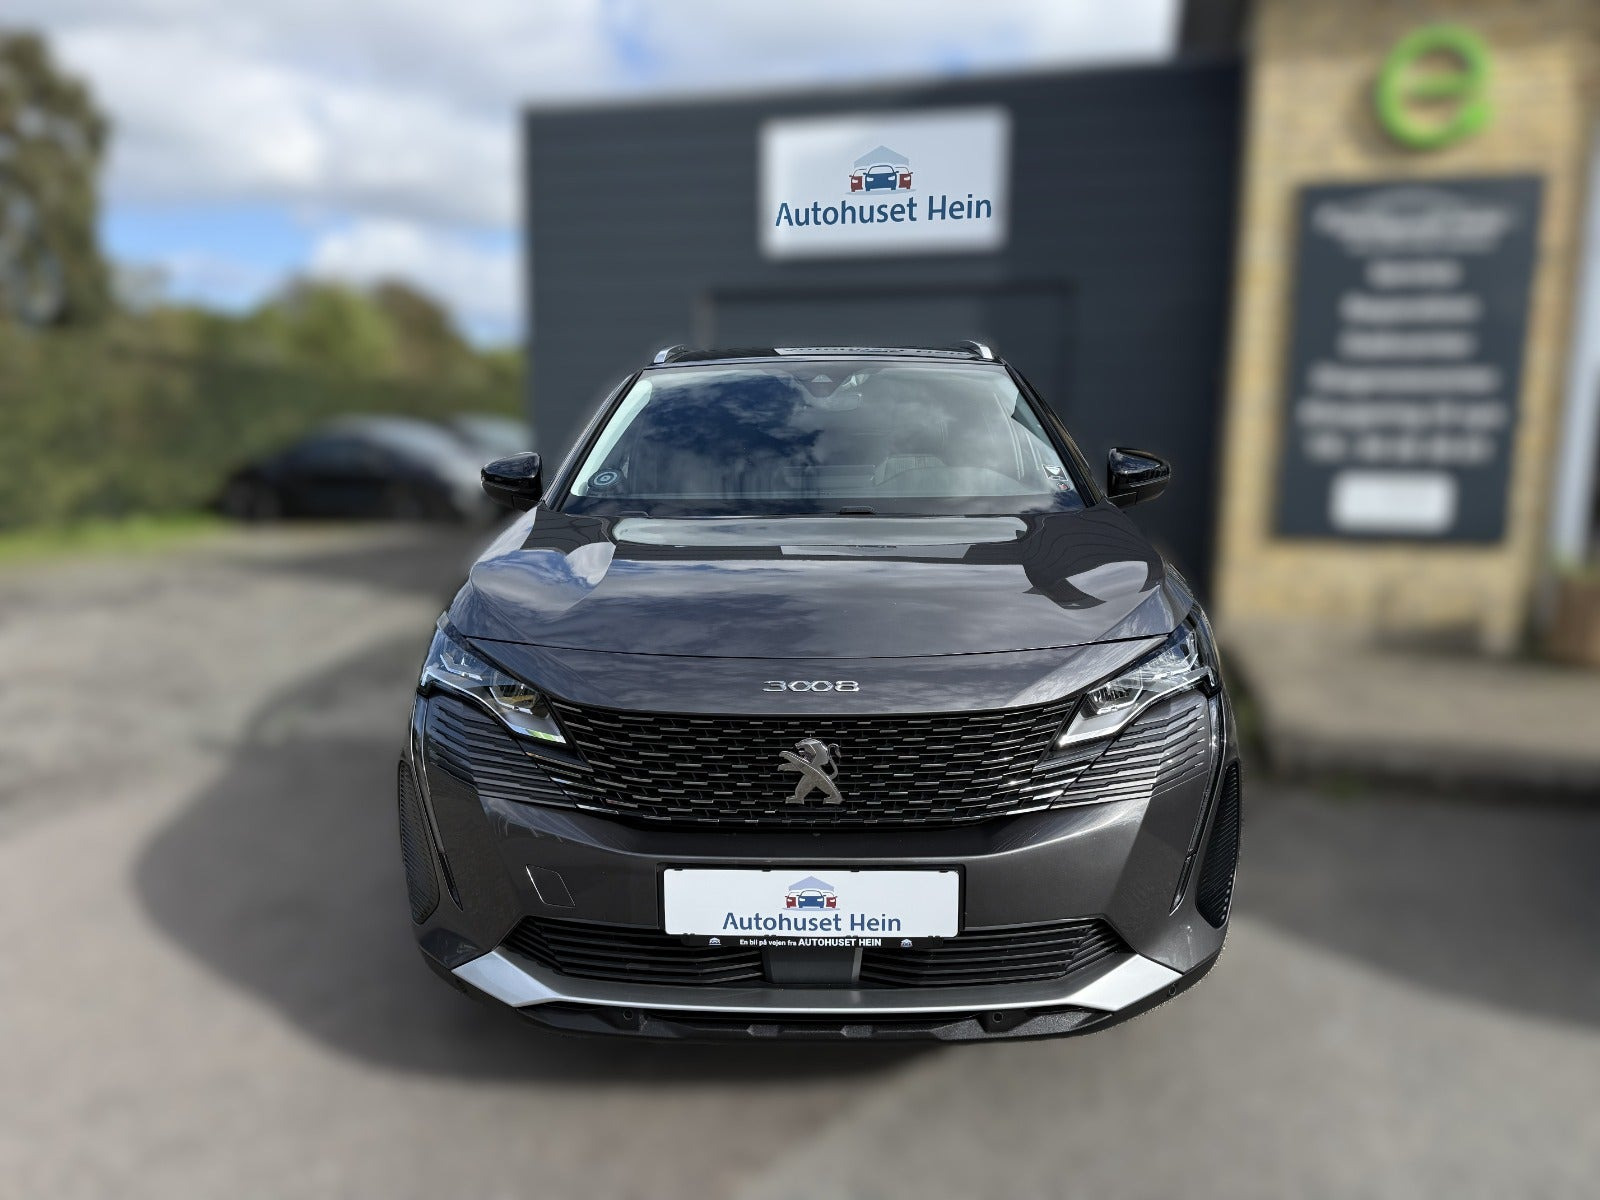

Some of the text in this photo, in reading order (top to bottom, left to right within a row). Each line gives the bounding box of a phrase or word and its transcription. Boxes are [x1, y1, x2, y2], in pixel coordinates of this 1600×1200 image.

[775, 193, 992, 227] Autohuset Hein
[762, 680, 860, 692] 3008
[722, 912, 901, 932] Autohuset Hein
[739, 938, 749, 946] En
[749, 938, 758, 946] bil
[787, 938, 797, 946] fra
[797, 937, 857, 947] AUTOHUSET
[858, 938, 882, 947] HEIN
